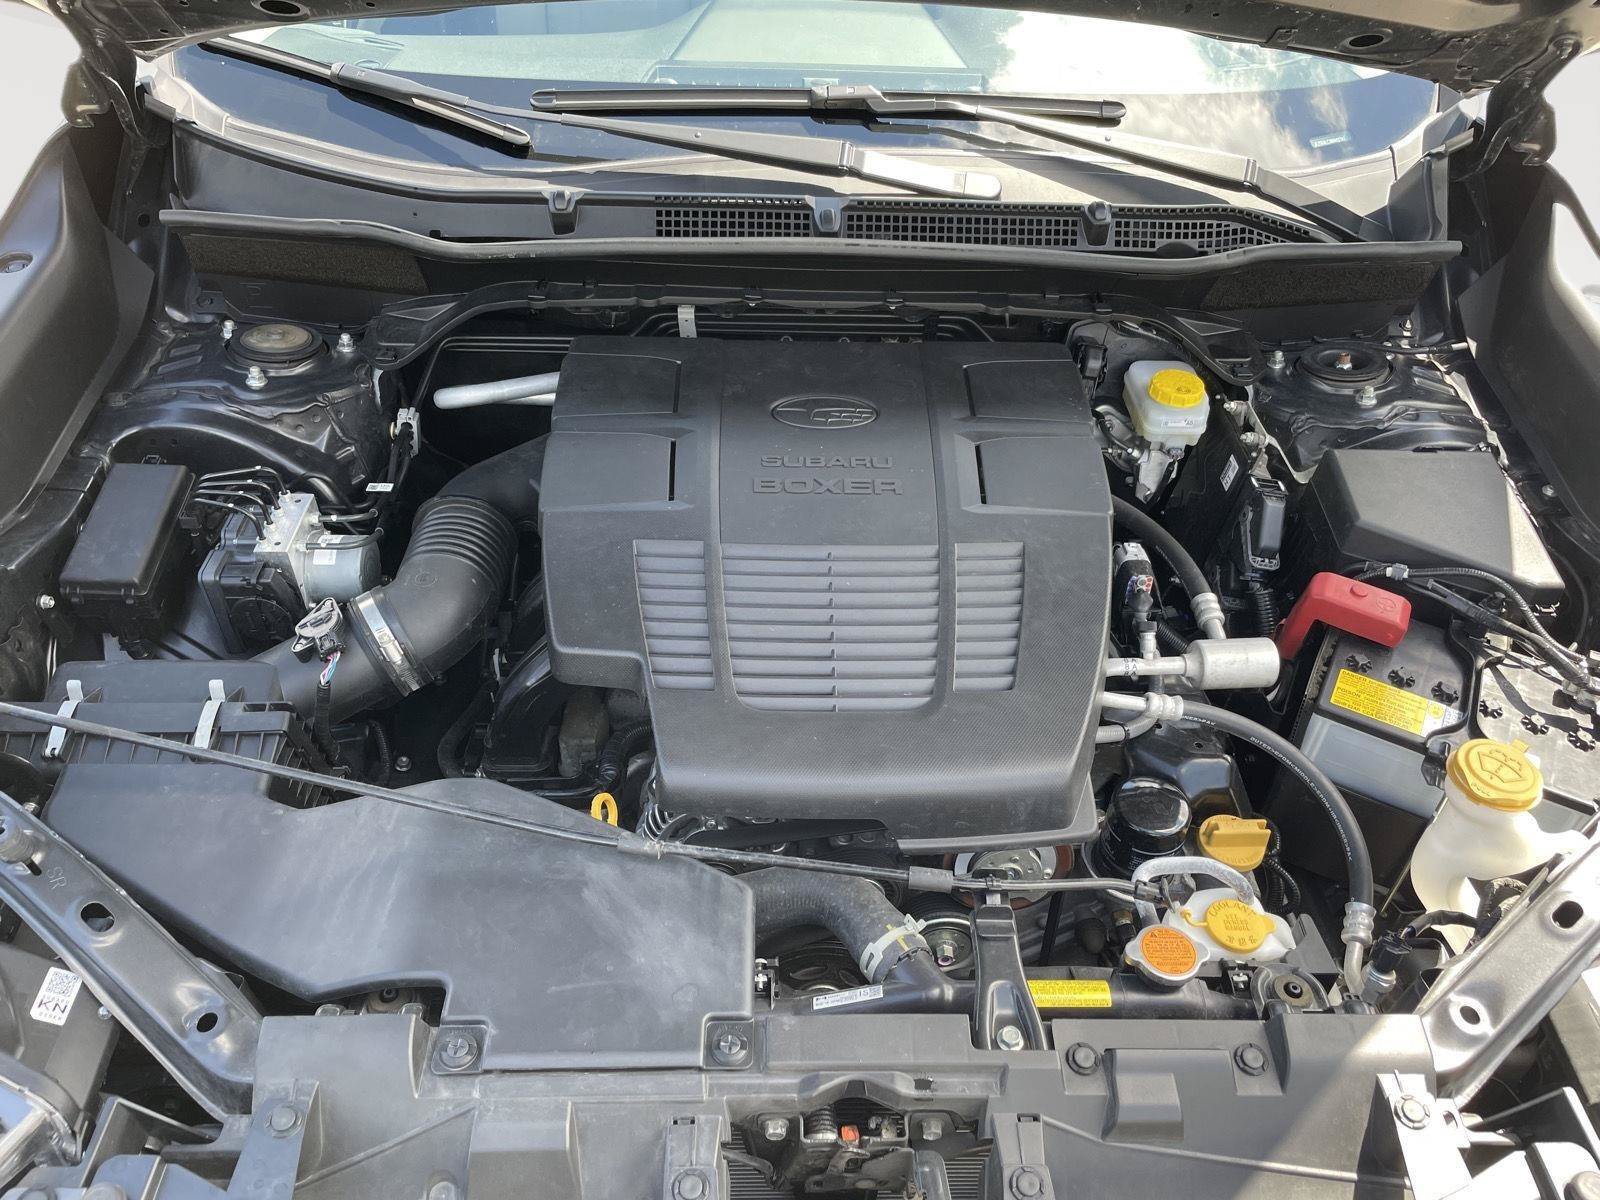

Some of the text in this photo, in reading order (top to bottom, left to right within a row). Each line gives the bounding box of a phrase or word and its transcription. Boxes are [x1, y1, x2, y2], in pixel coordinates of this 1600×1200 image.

[761, 455, 893, 468] SUBARU
[752, 477, 902, 495] BOXER
[1342, 670, 1367, 682] DANGER
[1336, 686, 1361, 698] POISON
[47, 866, 67, 890] SR
[38, 999, 67, 1013] KN
